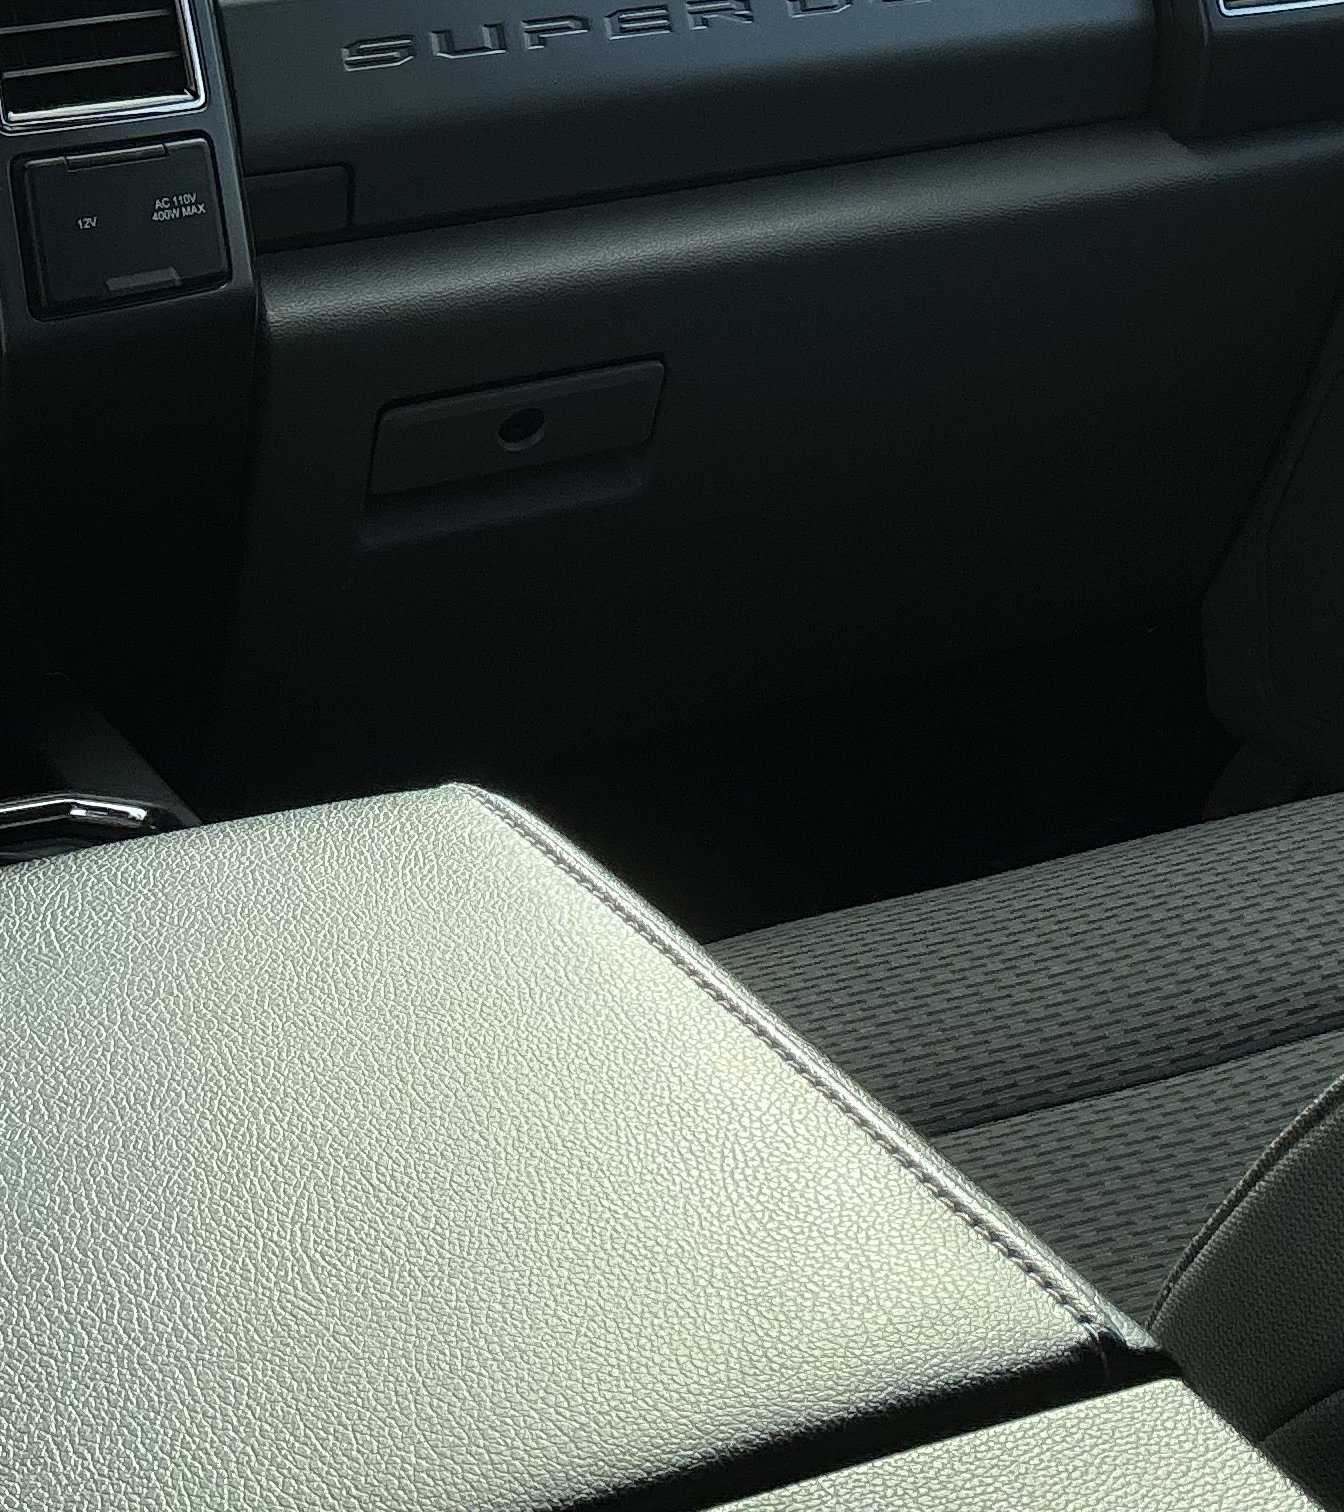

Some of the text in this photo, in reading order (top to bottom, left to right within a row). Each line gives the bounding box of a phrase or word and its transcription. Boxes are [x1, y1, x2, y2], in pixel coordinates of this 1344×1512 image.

[154, 192, 198, 210] AC 110V
[151, 202, 208, 222] 400W MAX
[77, 216, 99, 230] 12V
